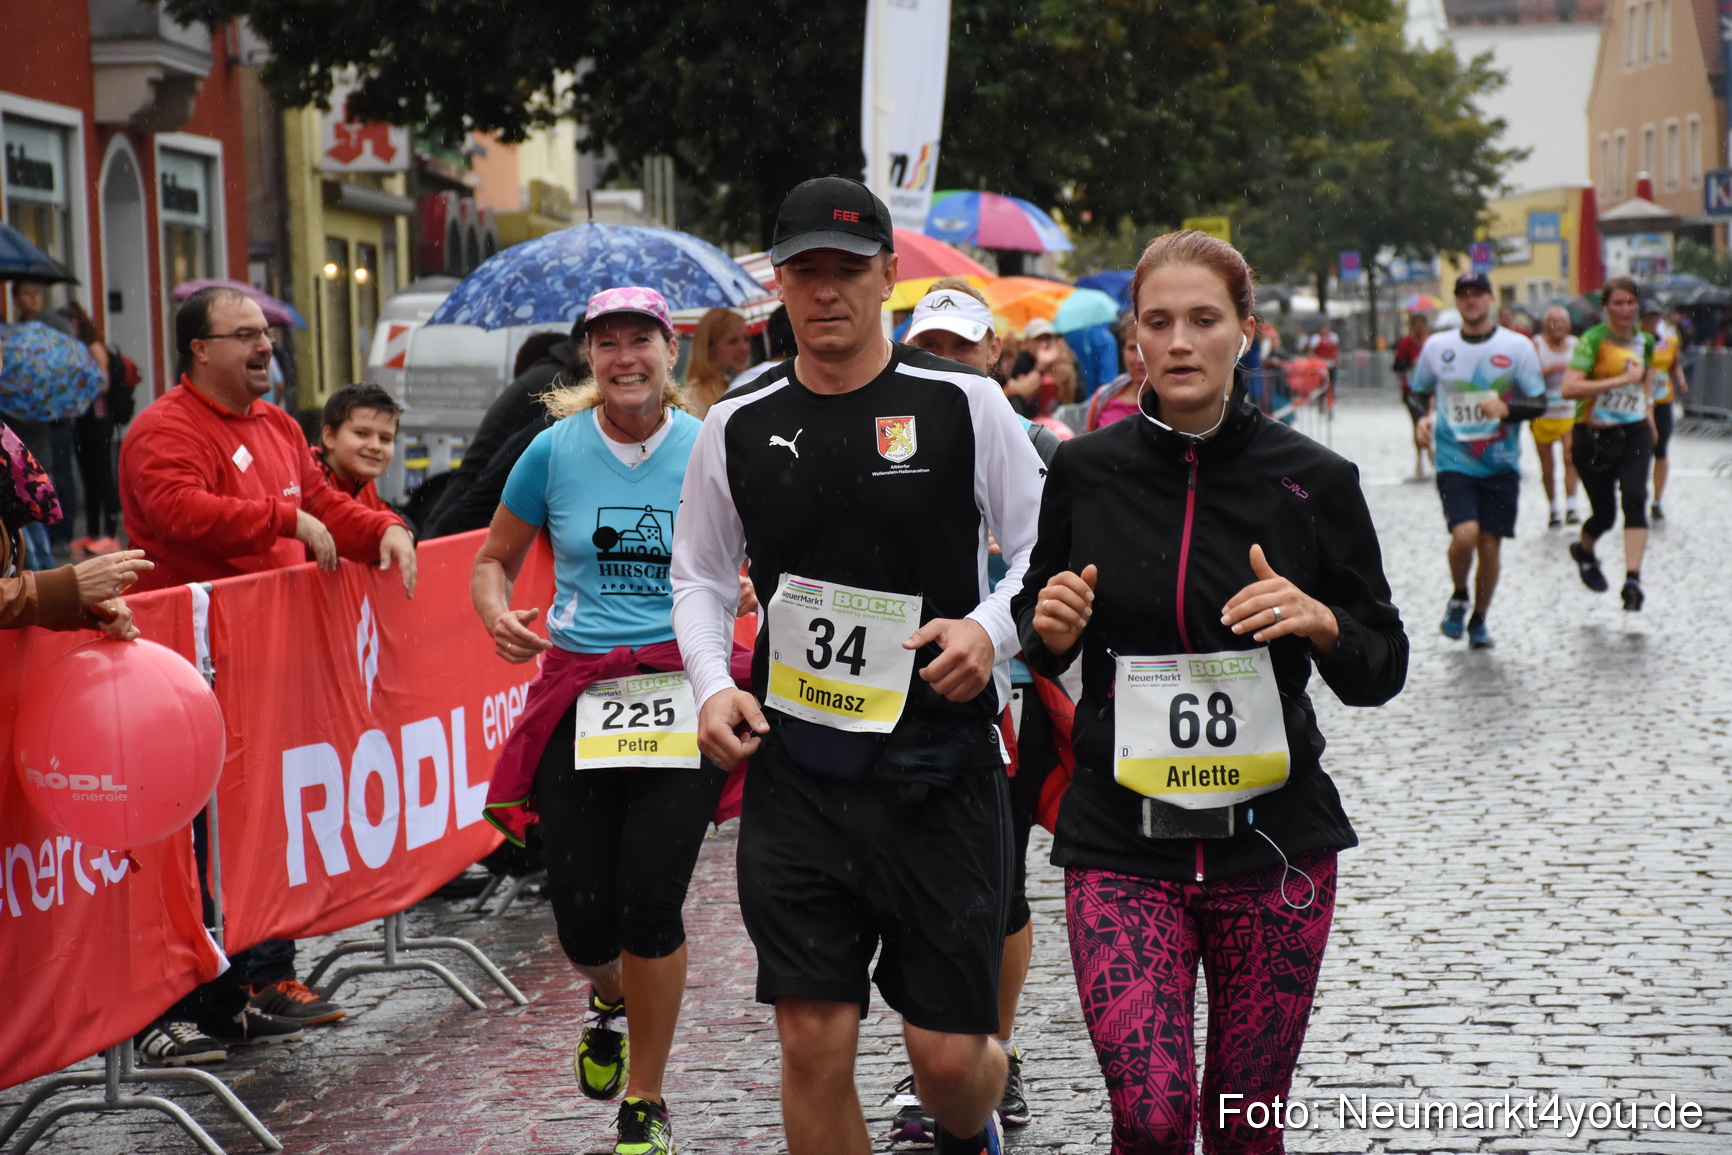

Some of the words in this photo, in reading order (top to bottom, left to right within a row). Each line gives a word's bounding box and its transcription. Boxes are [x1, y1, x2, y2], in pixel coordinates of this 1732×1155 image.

[598, 563, 669, 580] HIRSCH
[832, 589, 907, 618] BOCK
[806, 617, 867, 677] 34
[1127, 673, 1182, 683] NeuerMarkt
[1188, 656, 1259, 678] BOCK
[626, 673, 685, 694] BOCK
[798, 678, 866, 713] Tomasz
[602, 697, 676, 731] 225
[1169, 691, 1237, 749] 68
[617, 738, 659, 753] Petra
[1166, 765, 1240, 788] Arlette
[71, 789, 128, 803] energie
